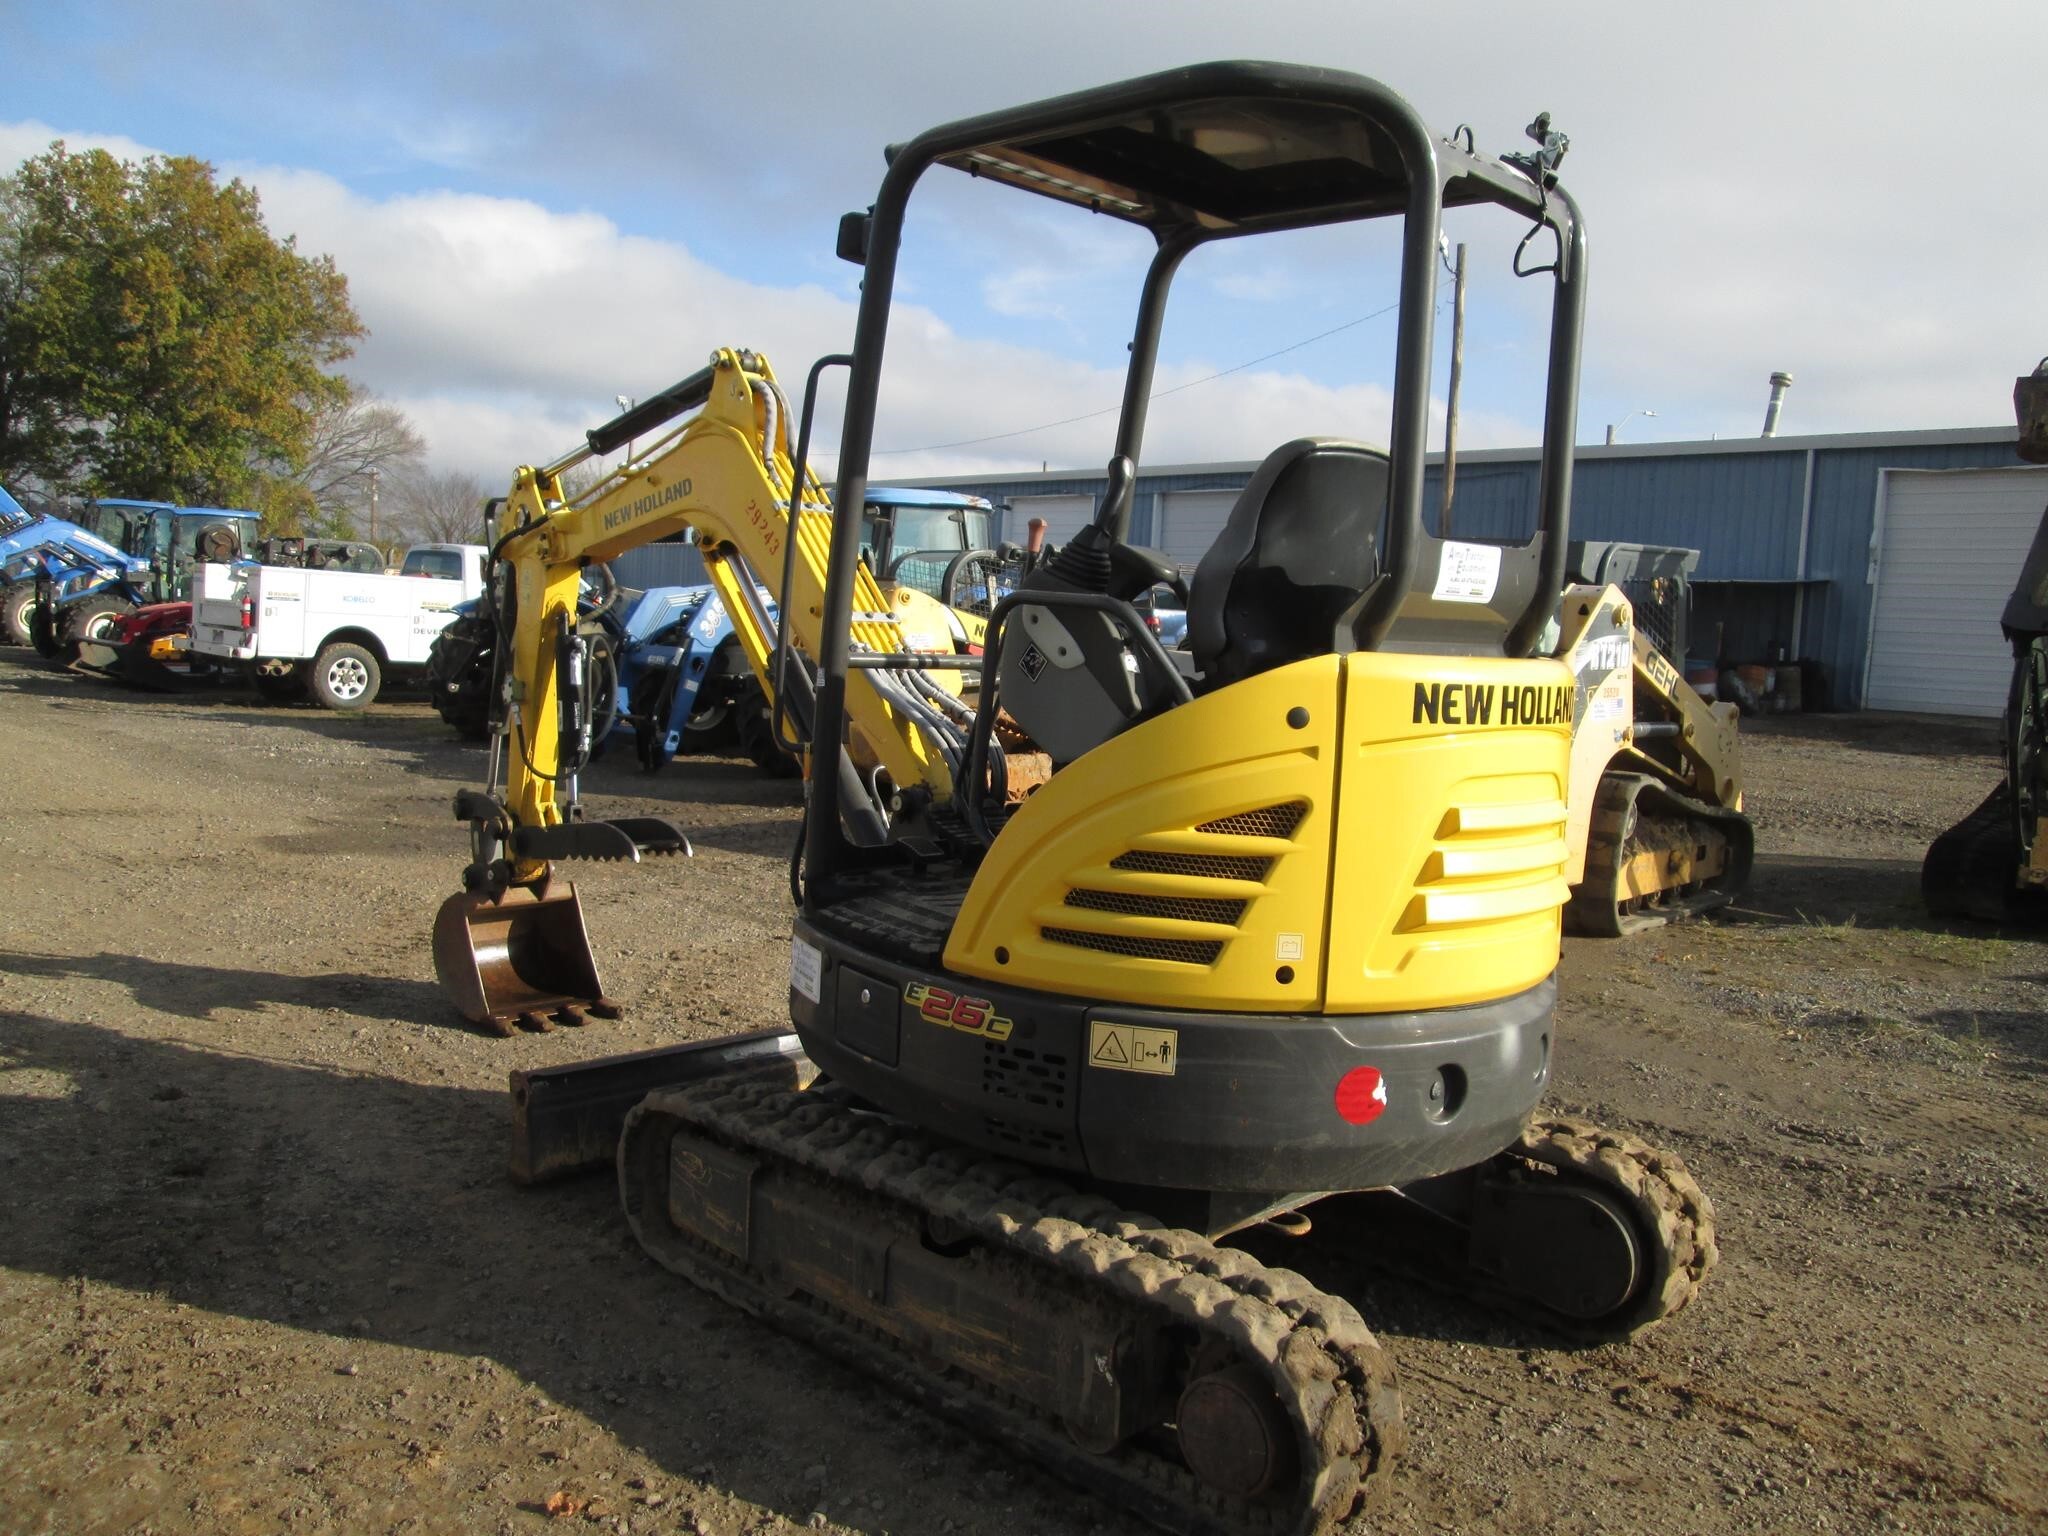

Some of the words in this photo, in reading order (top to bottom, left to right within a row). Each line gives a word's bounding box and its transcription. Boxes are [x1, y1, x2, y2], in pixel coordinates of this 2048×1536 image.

[604, 503, 631, 530] NEW
[634, 478, 692, 516] HOLLAND
[745, 499, 780, 556] 29243
[1645, 651, 1680, 702] GEHL
[1412, 682, 1495, 725] NEW
[1500, 685, 1574, 725] HOLLAND
